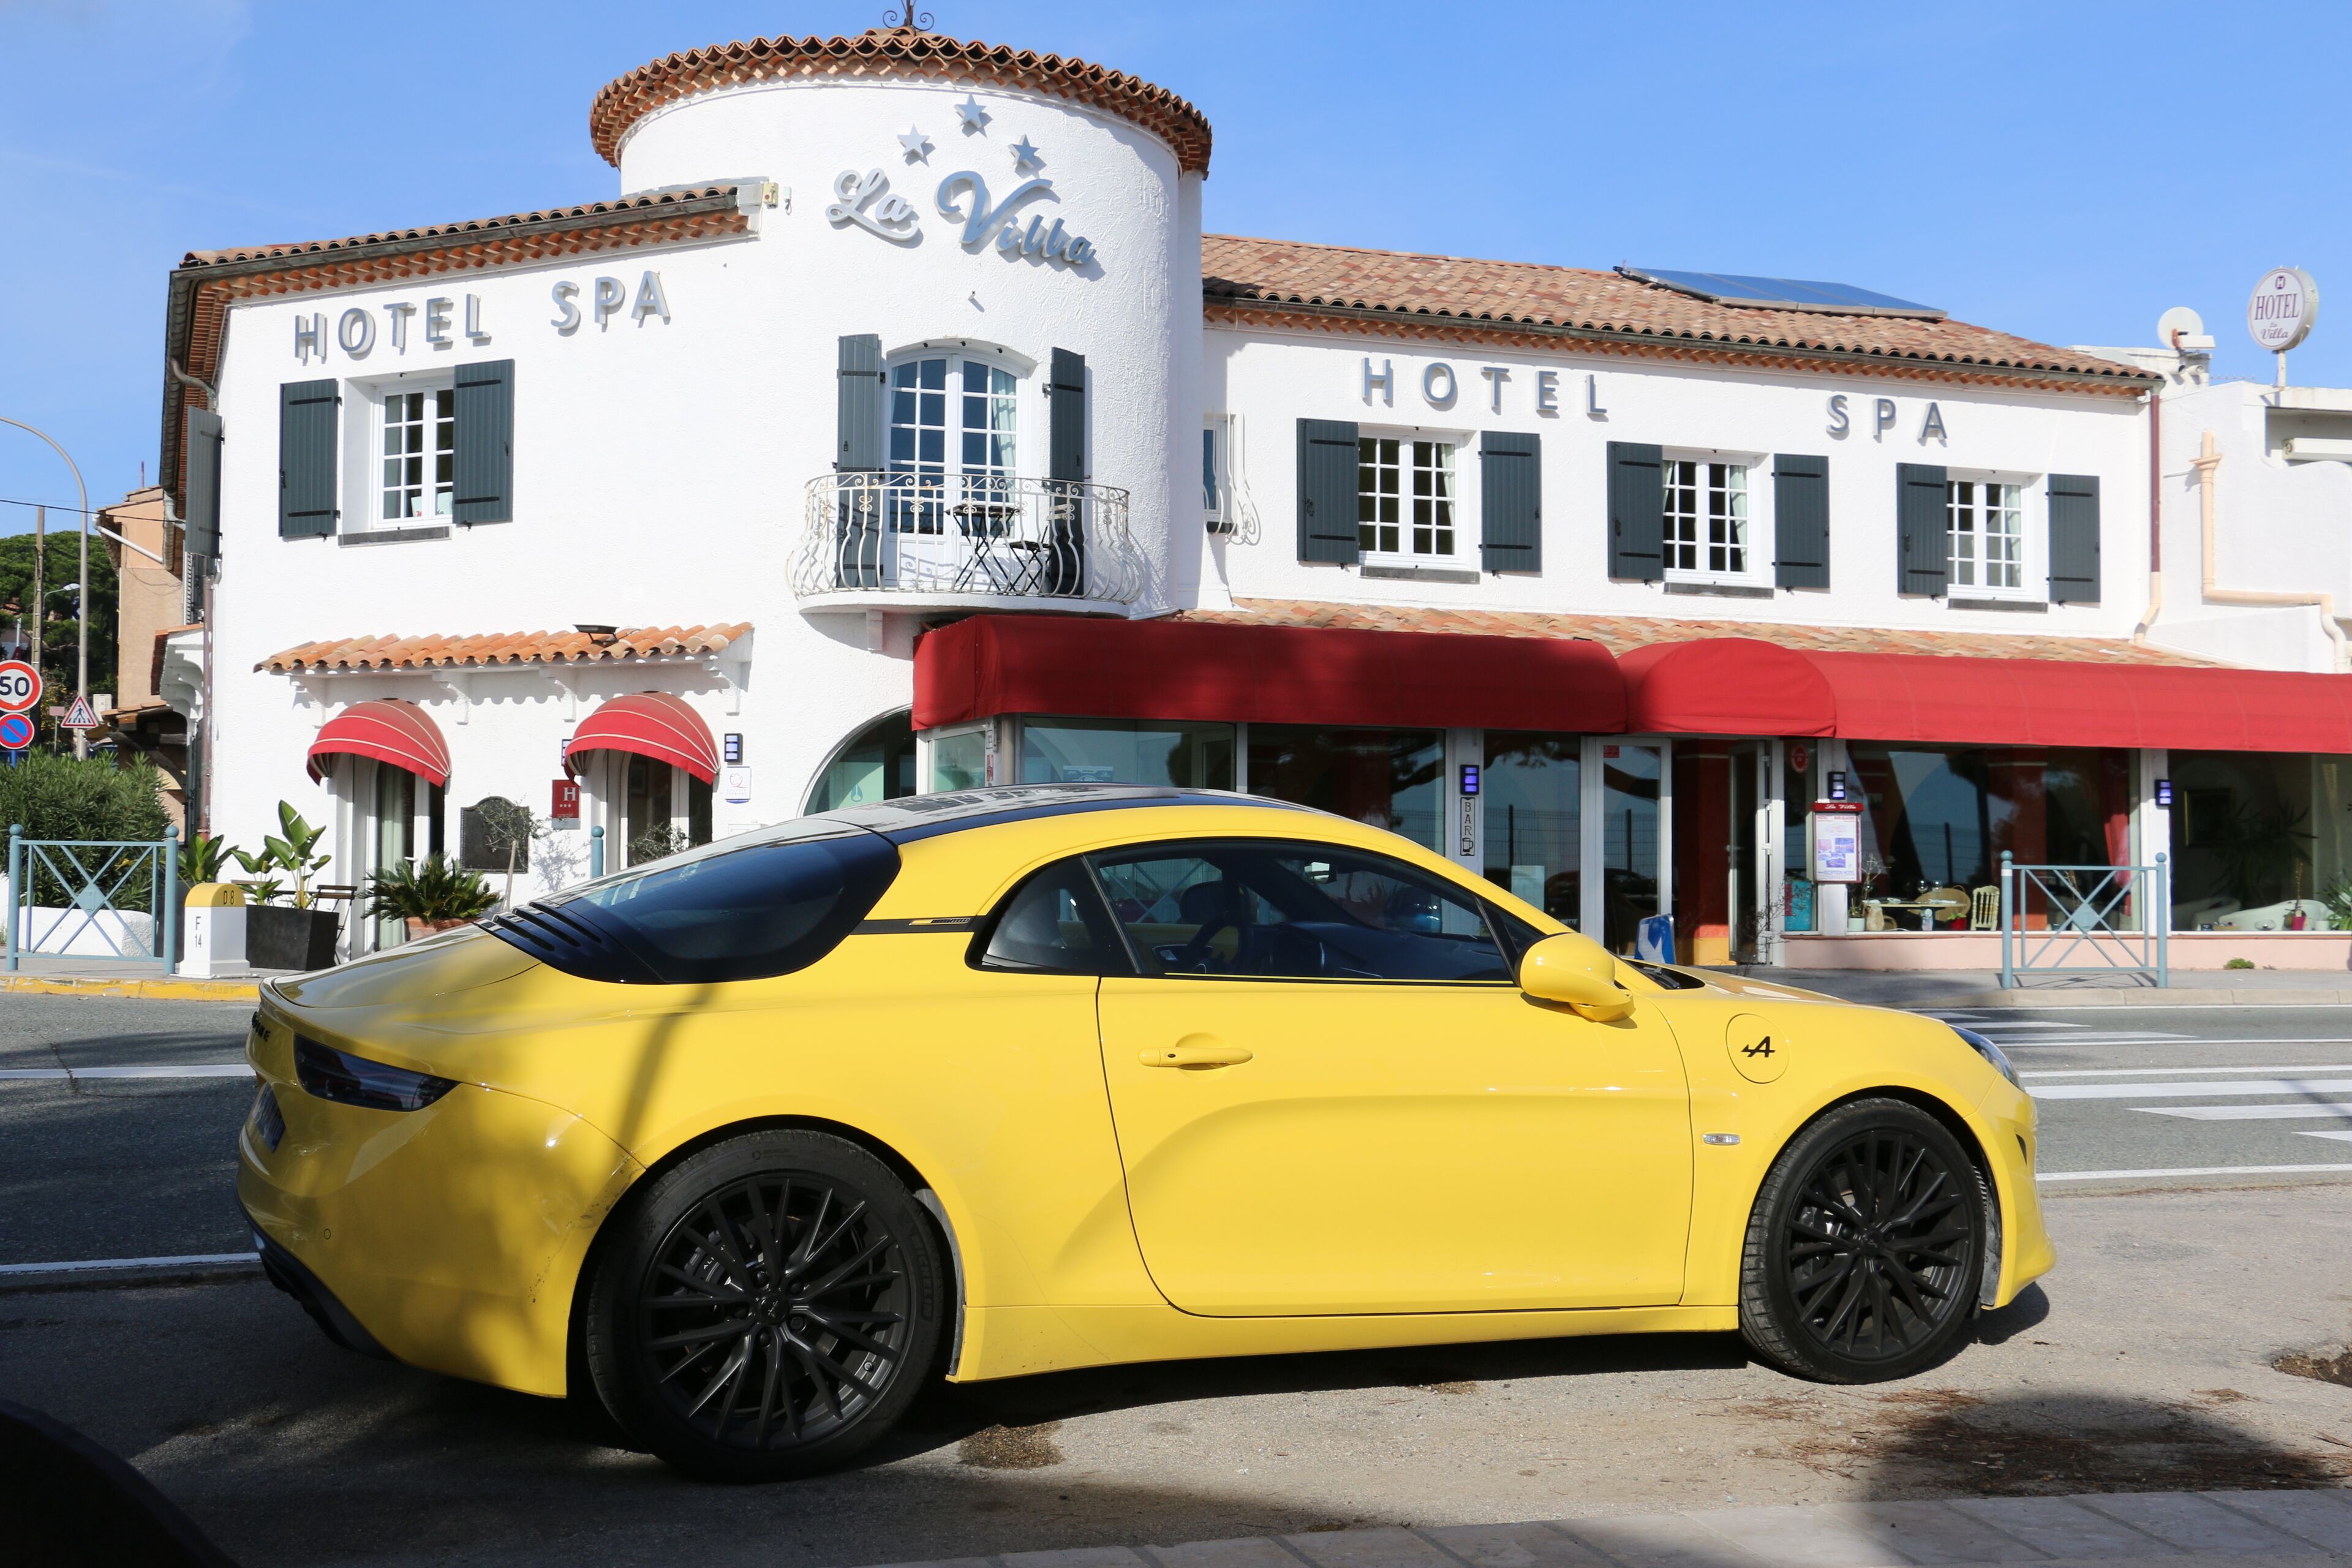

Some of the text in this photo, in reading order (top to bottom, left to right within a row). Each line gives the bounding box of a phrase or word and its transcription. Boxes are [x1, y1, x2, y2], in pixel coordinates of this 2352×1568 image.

[825, 168, 1096, 265] La Villa
[295, 270, 669, 360] HOTEL SPA
[2255, 293, 2299, 320] HOTEL
[2260, 328, 2290, 339] Villa
[1361, 357, 1948, 439] HOTEL SPA
[0, 676, 30, 696] 50
[564, 787, 577, 801] H
[196, 916, 201, 930] F
[195, 934, 202, 948] 14
